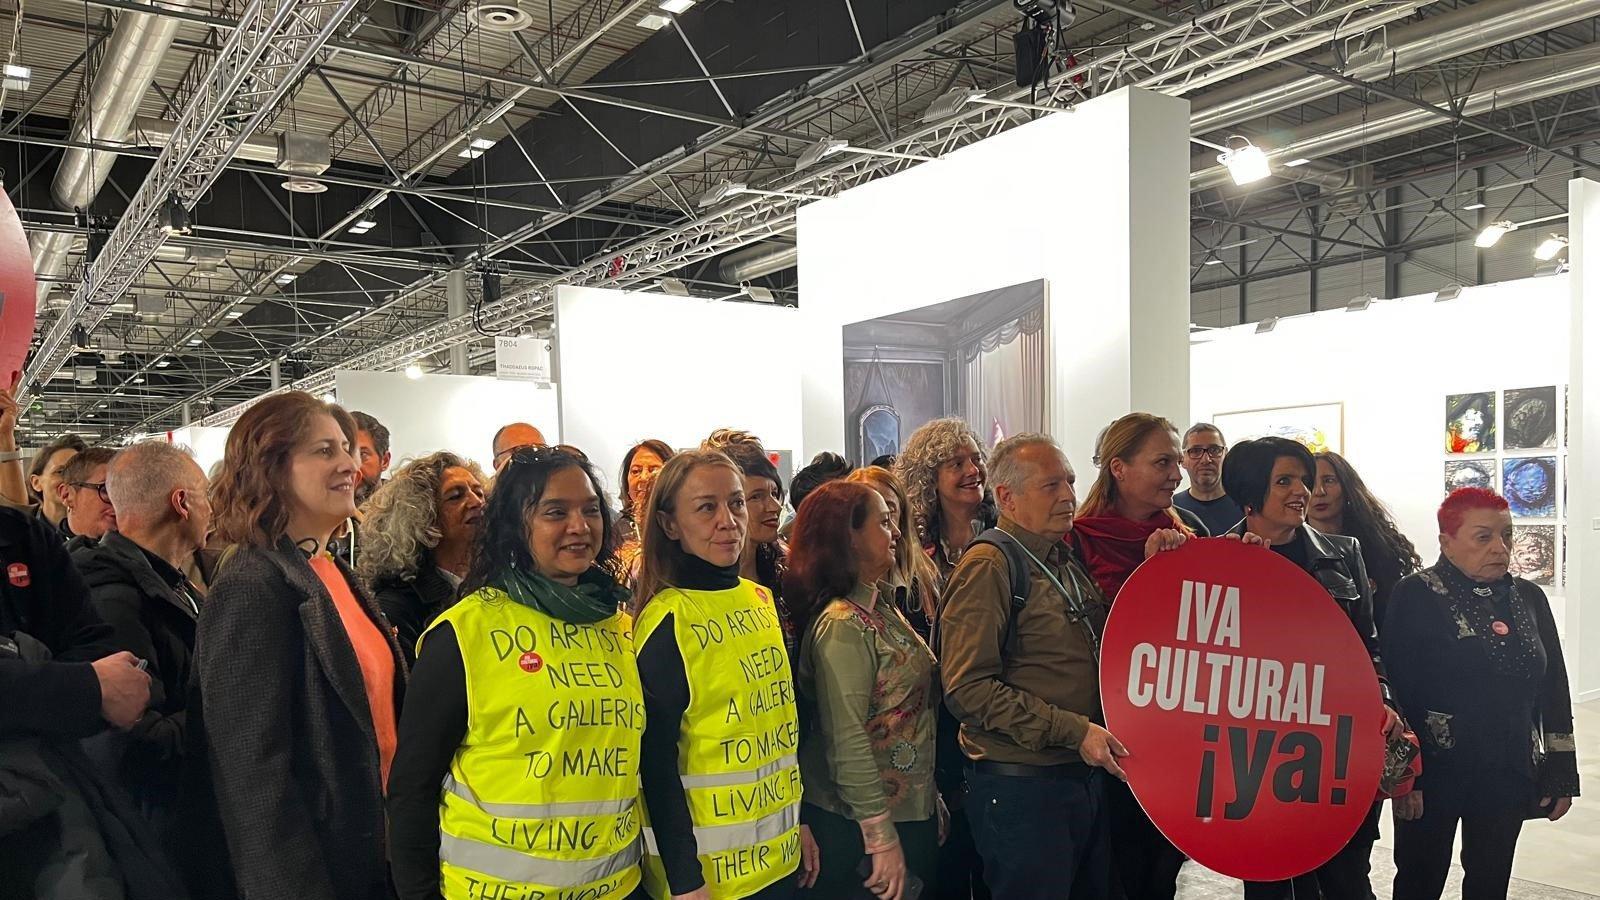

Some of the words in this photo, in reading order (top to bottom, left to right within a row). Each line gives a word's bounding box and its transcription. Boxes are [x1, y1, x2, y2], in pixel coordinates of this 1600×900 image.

[1176, 580, 1241, 648] IVA
[491, 625, 536, 661] DO
[691, 619, 723, 650] DO
[546, 663, 623, 689] NEED
[739, 646, 784, 683] NEED
[1127, 642, 1331, 726] CULTURAL
[515, 707, 535, 738] A
[548, 698, 646, 731] GALLERIS
[726, 697, 741, 724] A
[749, 676, 796, 717] GALLERIS
[525, 751, 552, 779] TO
[563, 748, 627, 777] MAKE
[720, 739, 752, 764] TO
[1196, 715, 1353, 820] ¡ya!
[713, 775, 785, 817] LIVING
[712, 845, 770, 884] THEIR
